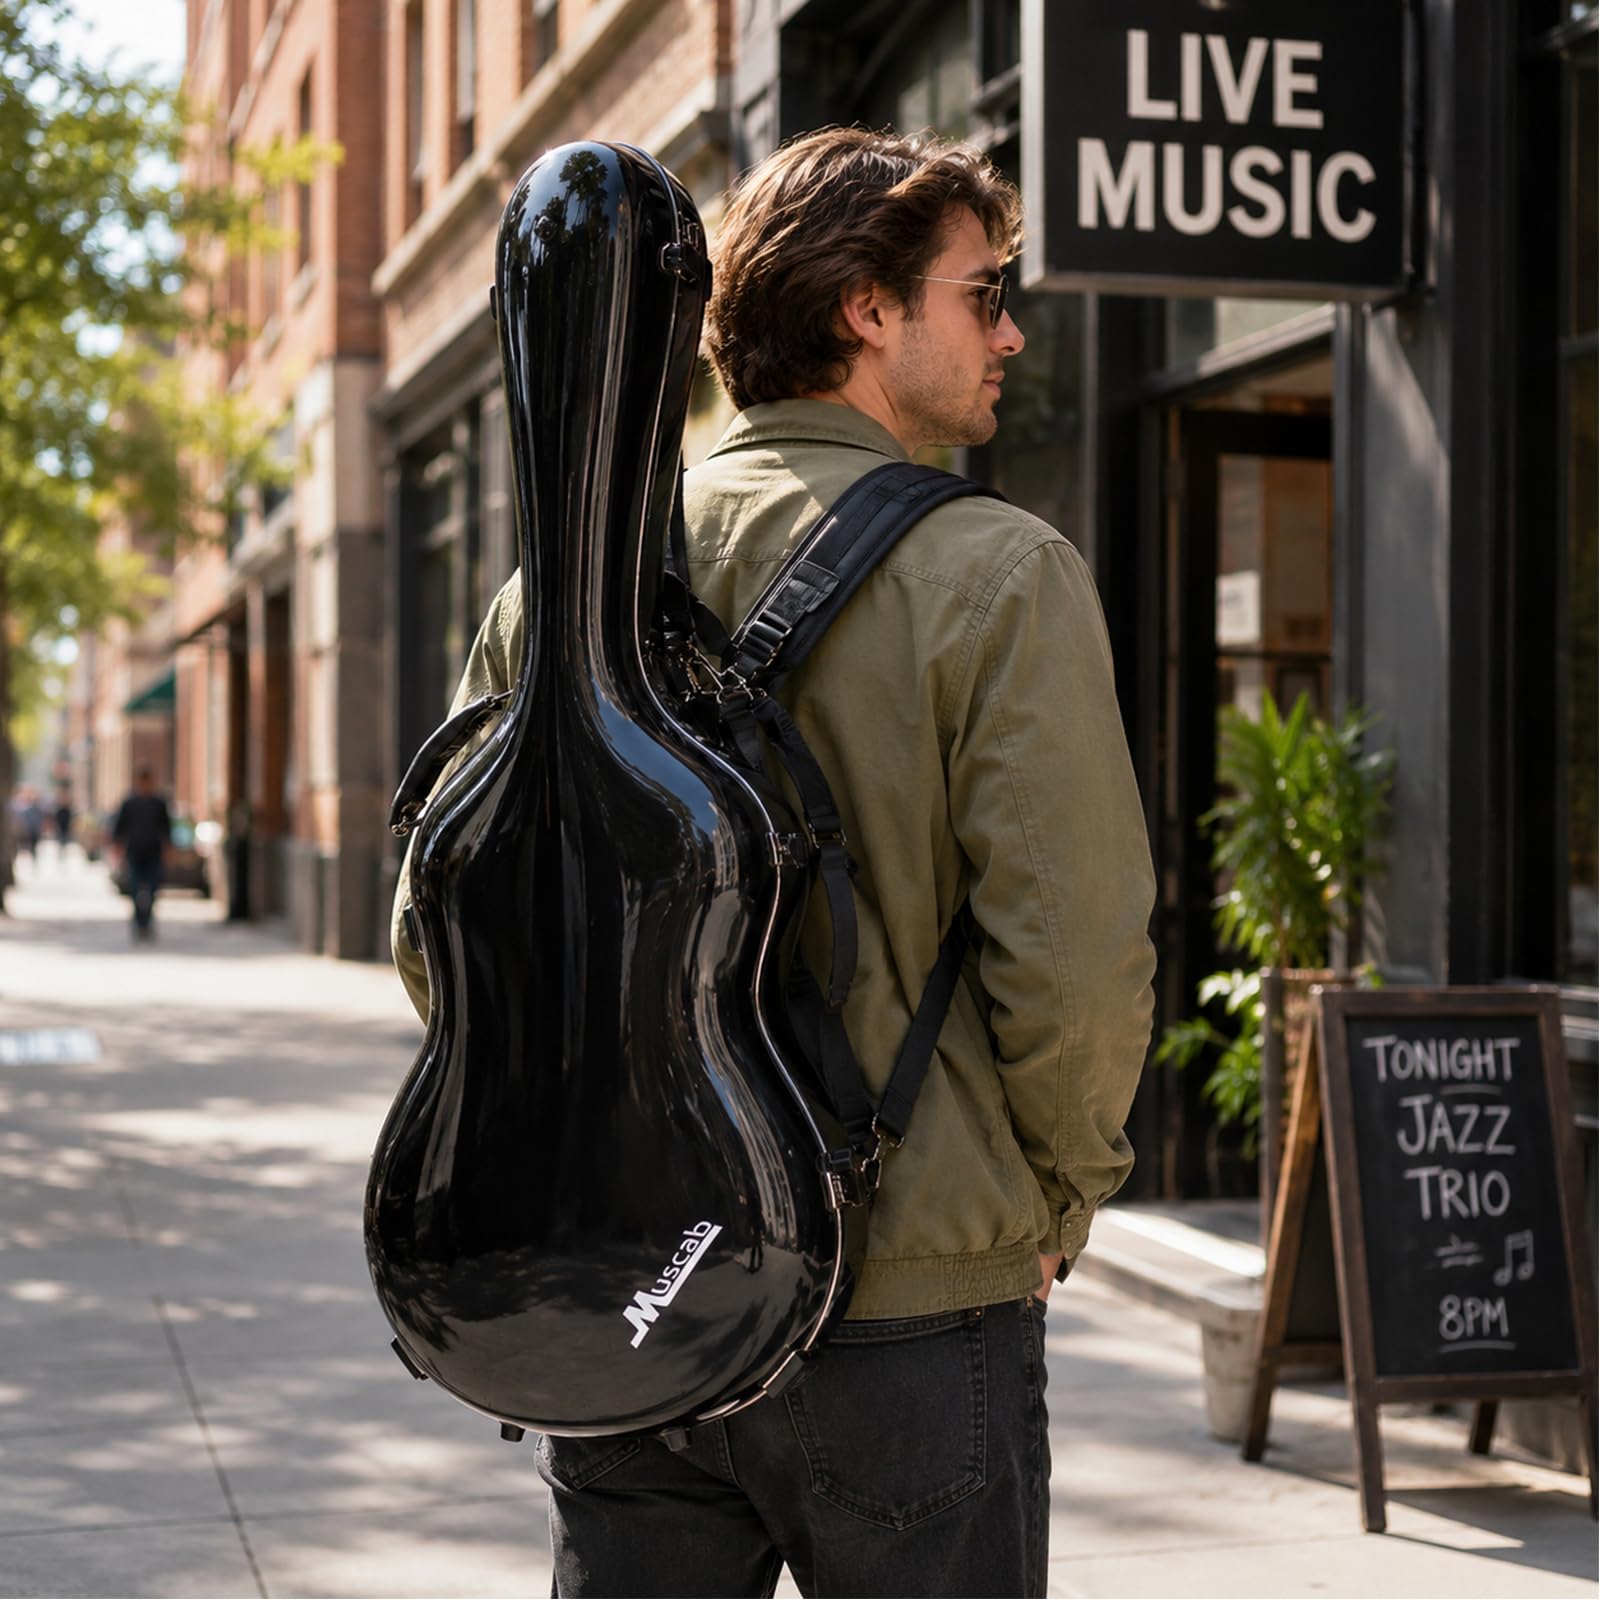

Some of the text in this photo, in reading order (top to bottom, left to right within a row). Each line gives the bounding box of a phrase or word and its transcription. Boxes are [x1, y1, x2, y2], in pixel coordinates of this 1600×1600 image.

[1127, 29, 1324, 129] LIVE
[1078, 137, 1377, 243] MUSIC
[1362, 1035, 1520, 1082] TONIGHT
[1397, 1094, 1516, 1155] JAZZ
[1404, 1166, 1511, 1221] TRIO
[622, 1221, 723, 1349] Muscab
[1439, 1295, 1509, 1340] 8PM
